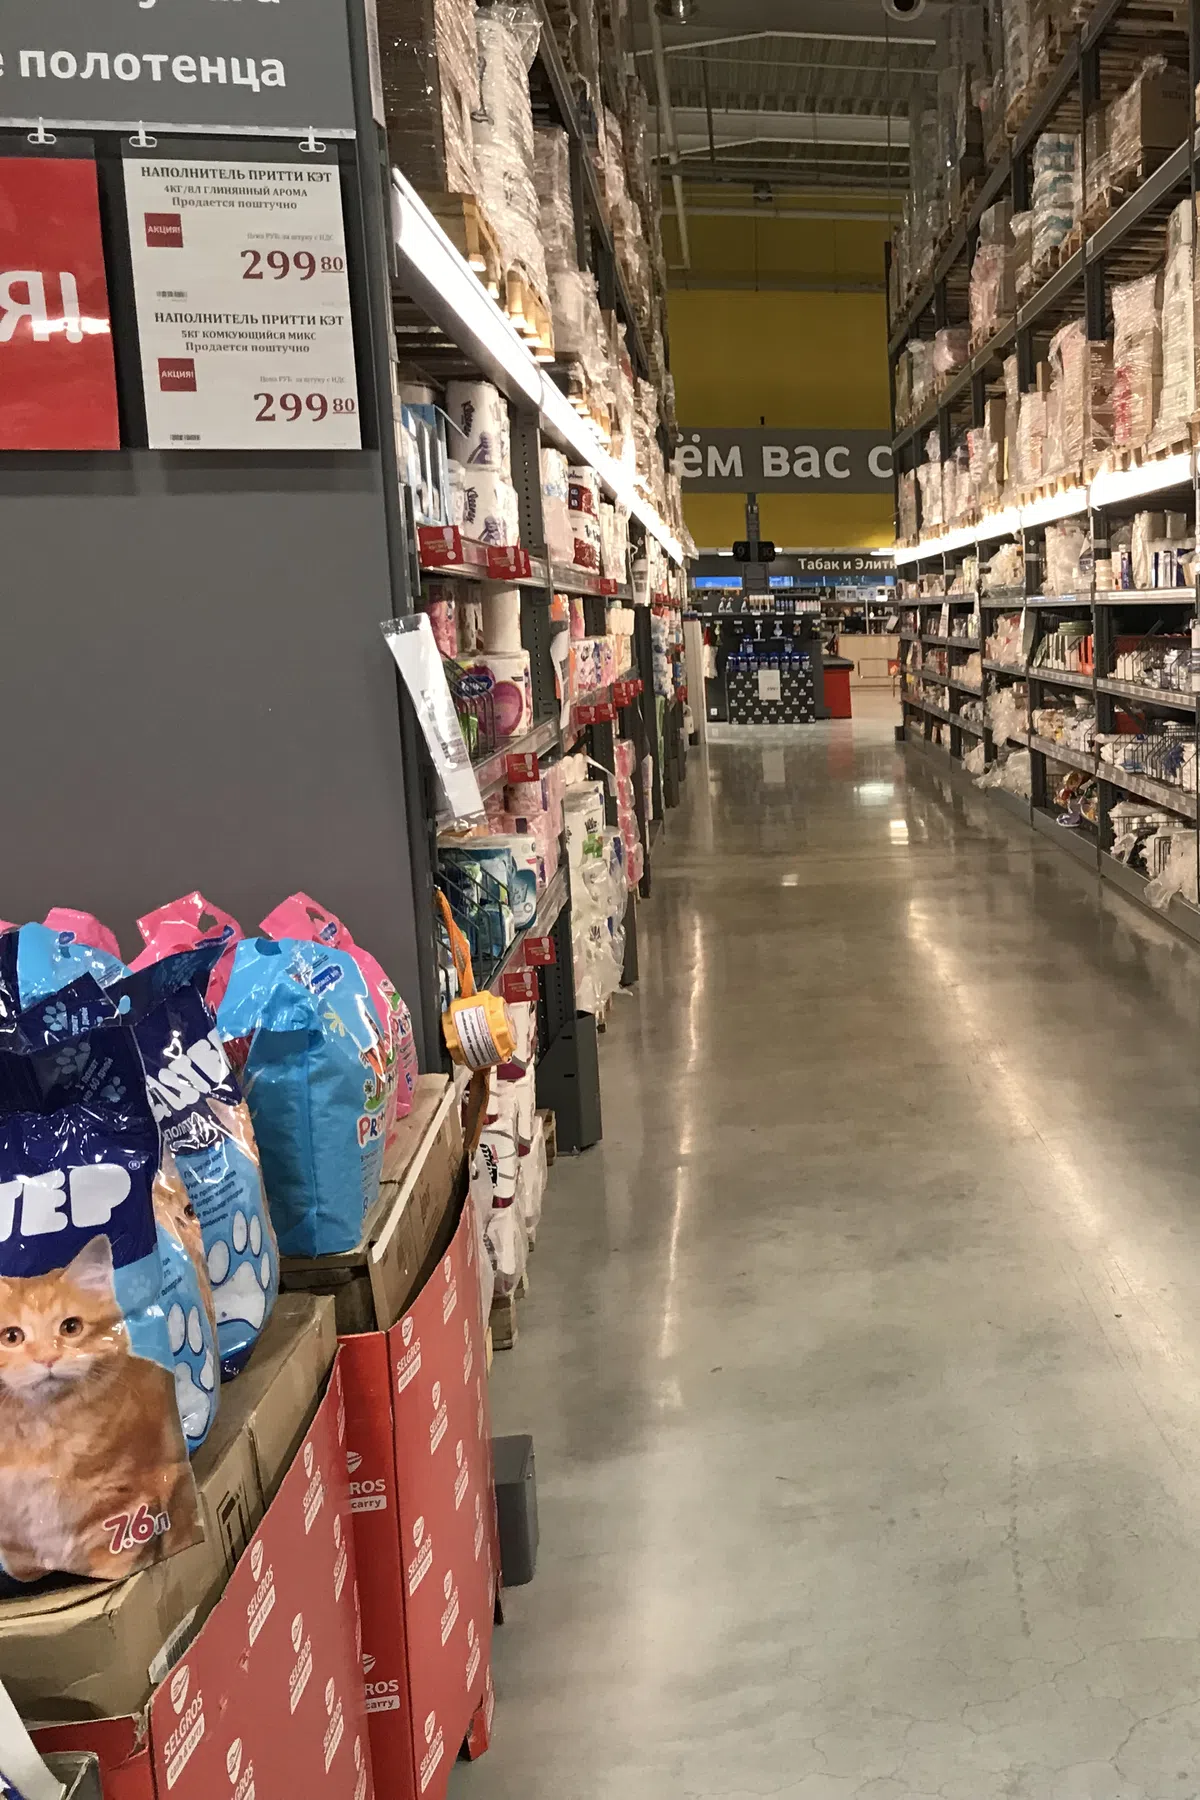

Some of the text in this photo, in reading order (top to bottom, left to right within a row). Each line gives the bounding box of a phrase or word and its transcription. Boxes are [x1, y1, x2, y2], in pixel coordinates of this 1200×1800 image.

[19, 50, 286, 92] полотенца
[141, 166, 332, 183] НАПОЛНИТЕЛЬ ПРИТТИ КЭТ
[204, 185, 270, 196] ГЛИНЯННЫЙ
[273, 188, 308, 198] АРОМА
[172, 197, 297, 211] Продается поштучно
[147, 225, 181, 235] АКЦИЯ!
[240, 249, 344, 281] 299 80
[154, 312, 344, 326] НАПОЛНИТЕЛЬ ПРИТТИ КЭТ
[181, 329, 317, 341] 5КГ КОМКУЮЩИЙСЯ МИКС
[186, 342, 310, 354] Продается поштучно
[161, 370, 194, 379] АКЦИЯ!
[253, 393, 356, 422] 299 80
[762, 445, 850, 479] вас
[867, 445, 894, 479] с
[798, 557, 898, 570] Табак и Элитн
[397, 1337, 420, 1375] SELGROS
[351, 1498, 381, 1509] carry
[408, 1533, 432, 1579] SELGROS
[247, 1564, 273, 1624] SELGROS
[164, 1689, 203, 1764] SELGROS
